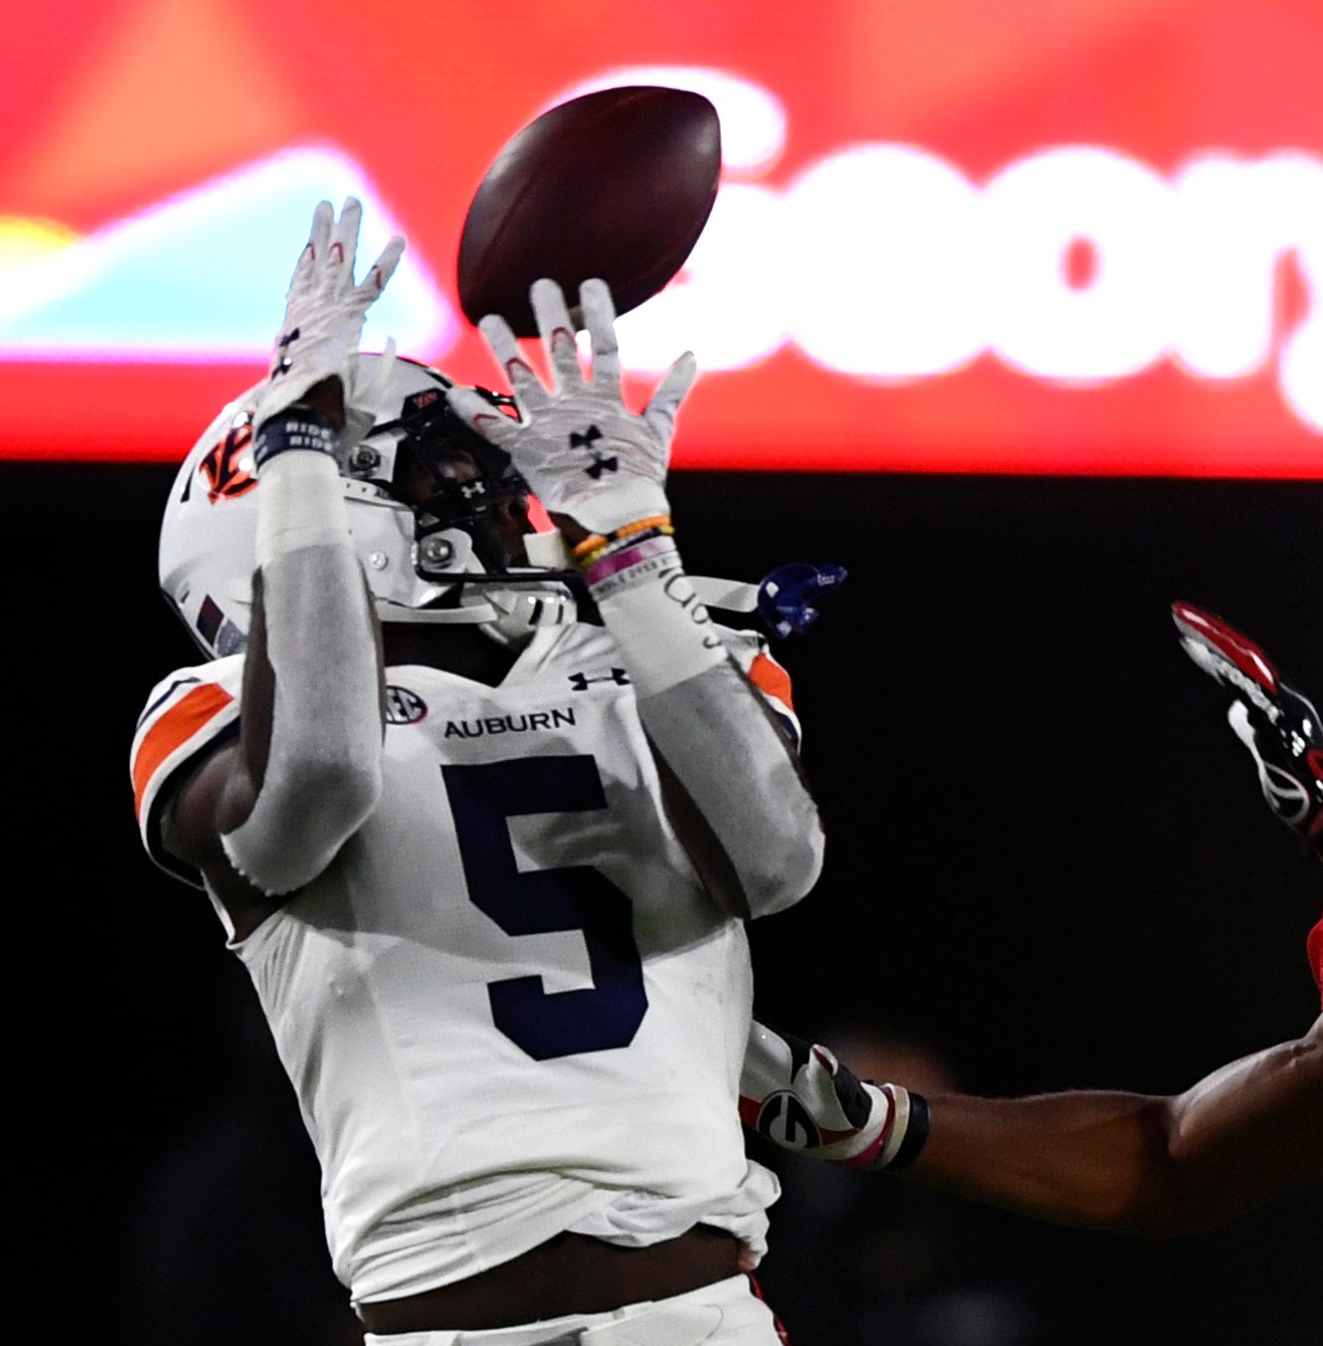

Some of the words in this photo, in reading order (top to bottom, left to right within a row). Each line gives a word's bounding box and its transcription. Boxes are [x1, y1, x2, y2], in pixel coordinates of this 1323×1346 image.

[386, 688, 422, 722] EC
[443, 708, 577, 739] AUBURN
[440, 754, 649, 1062] 5
